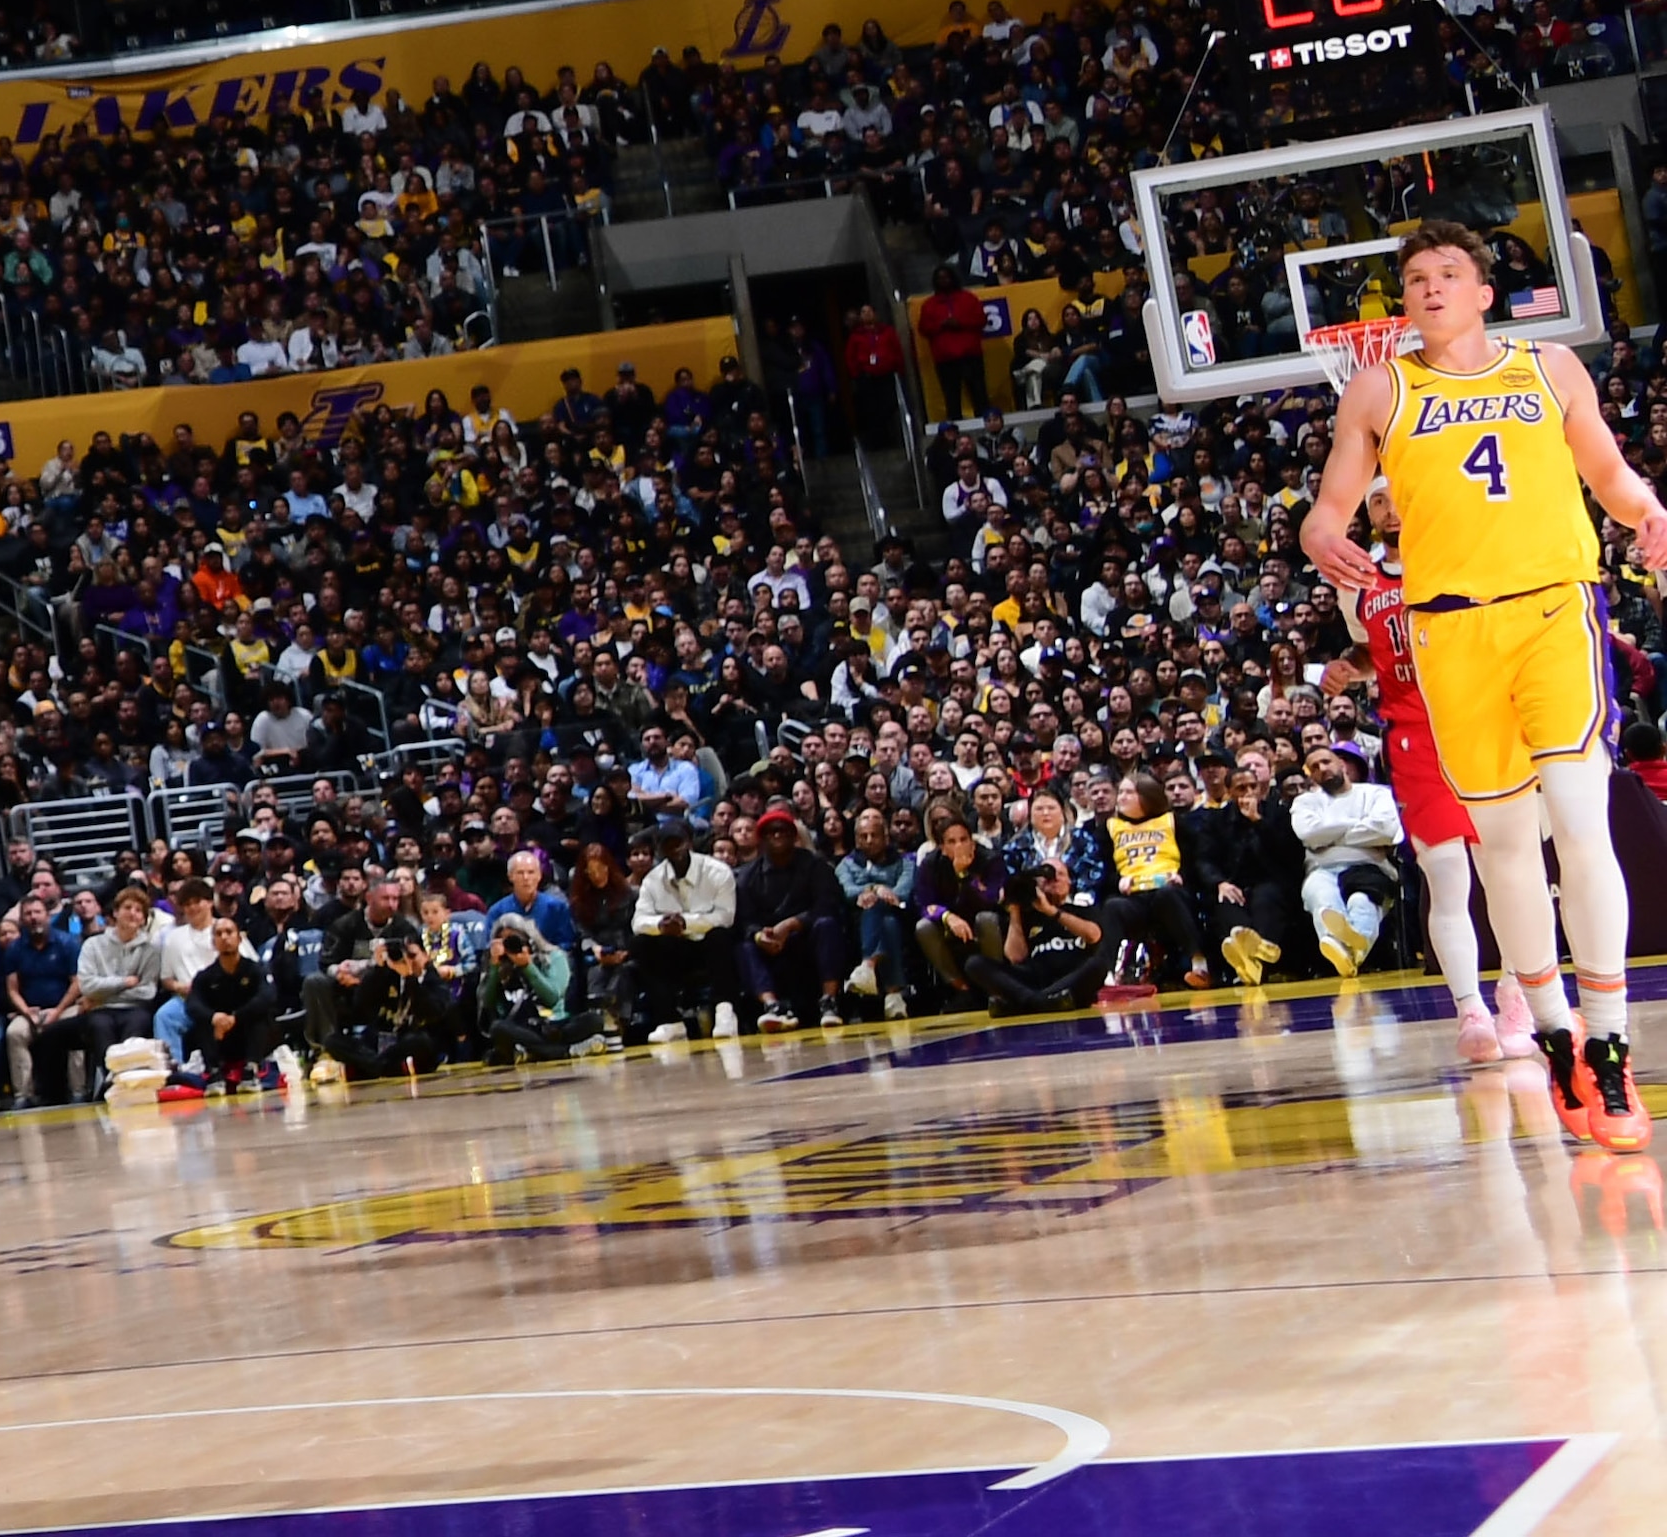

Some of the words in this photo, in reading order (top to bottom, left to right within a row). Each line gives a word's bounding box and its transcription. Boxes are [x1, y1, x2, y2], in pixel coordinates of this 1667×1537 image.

[1293, 25, 1411, 64] TISSOT
[17, 56, 386, 145] LAKERS
[1409, 394, 1542, 436] LAKERS
[1460, 432, 1509, 501] 4
